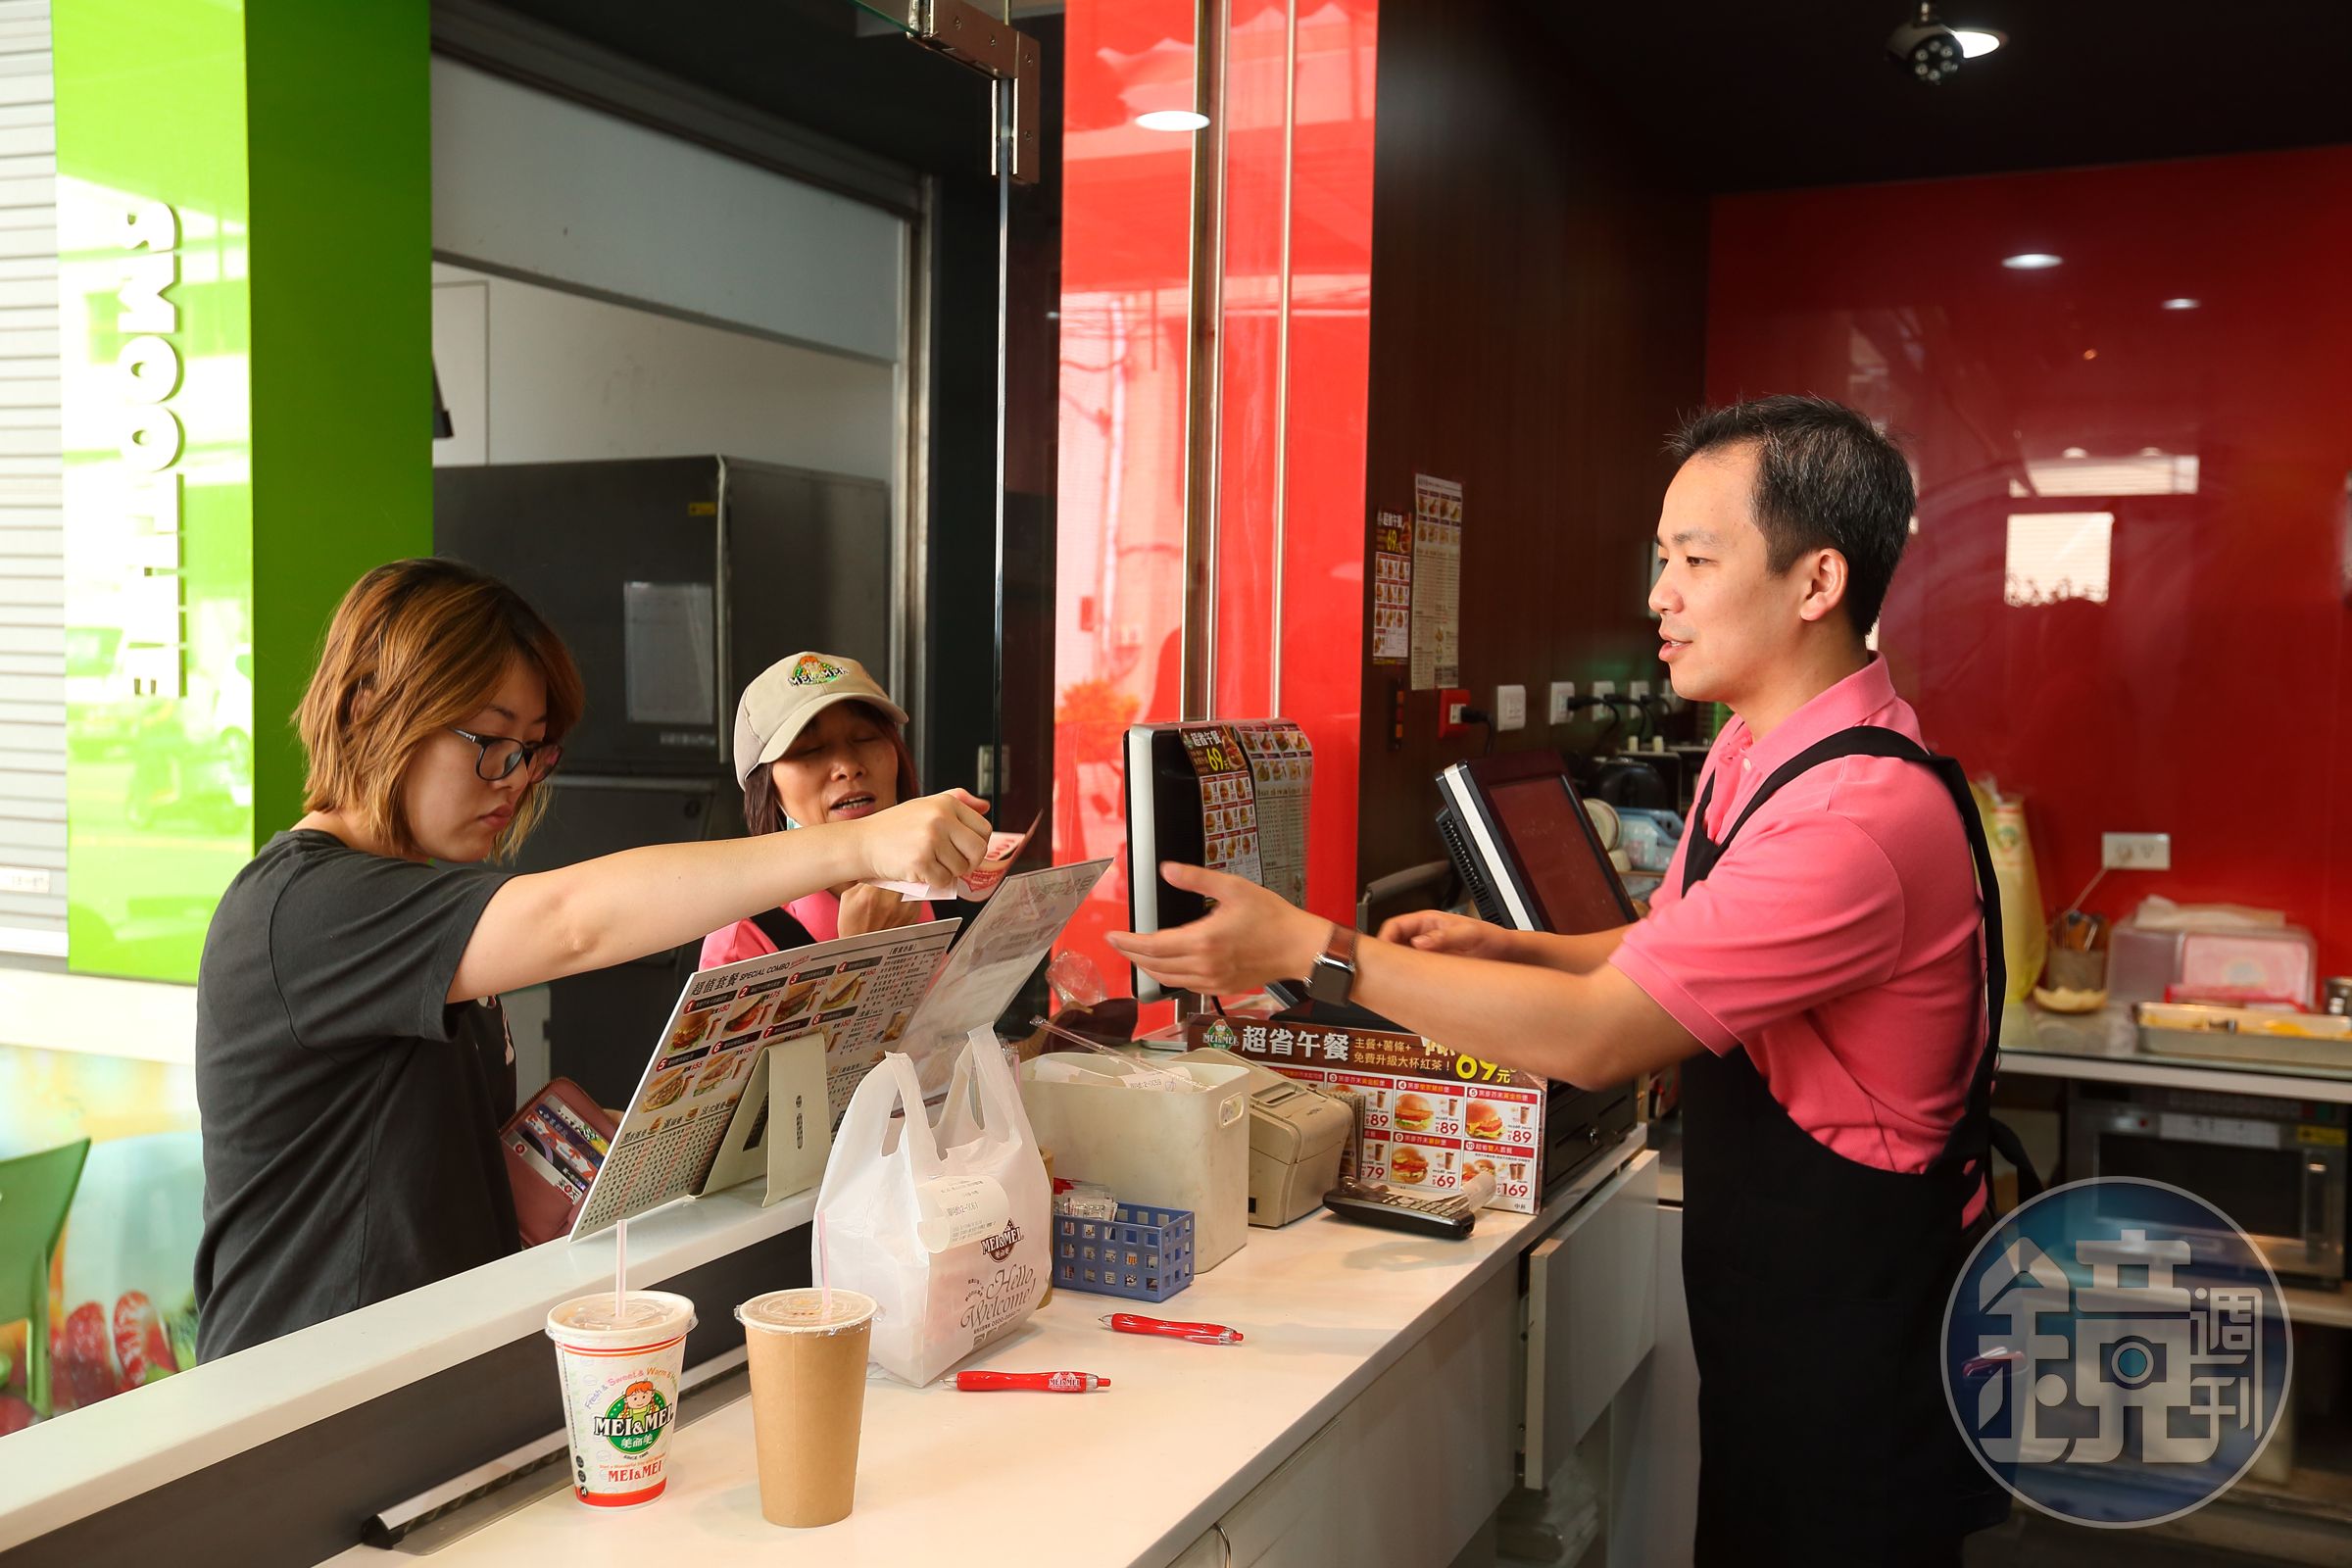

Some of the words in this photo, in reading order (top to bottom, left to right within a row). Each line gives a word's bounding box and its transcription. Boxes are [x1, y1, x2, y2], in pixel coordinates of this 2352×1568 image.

[691, 971, 739, 997] 超值套餐
[739, 967, 765, 982] SPECIAL
[767, 961, 791, 974] COMBO
[1242, 1025, 1349, 1062] 超省午餐
[981, 1226, 1021, 1255] MEI&MEI
[986, 1263, 1034, 1299] Hello
[608, 1371, 637, 1386] Sweet
[647, 1366, 667, 1377] Warm
[593, 1403, 674, 1437] MEI&MEI
[607, 1460, 662, 1483] MEI&MEI
